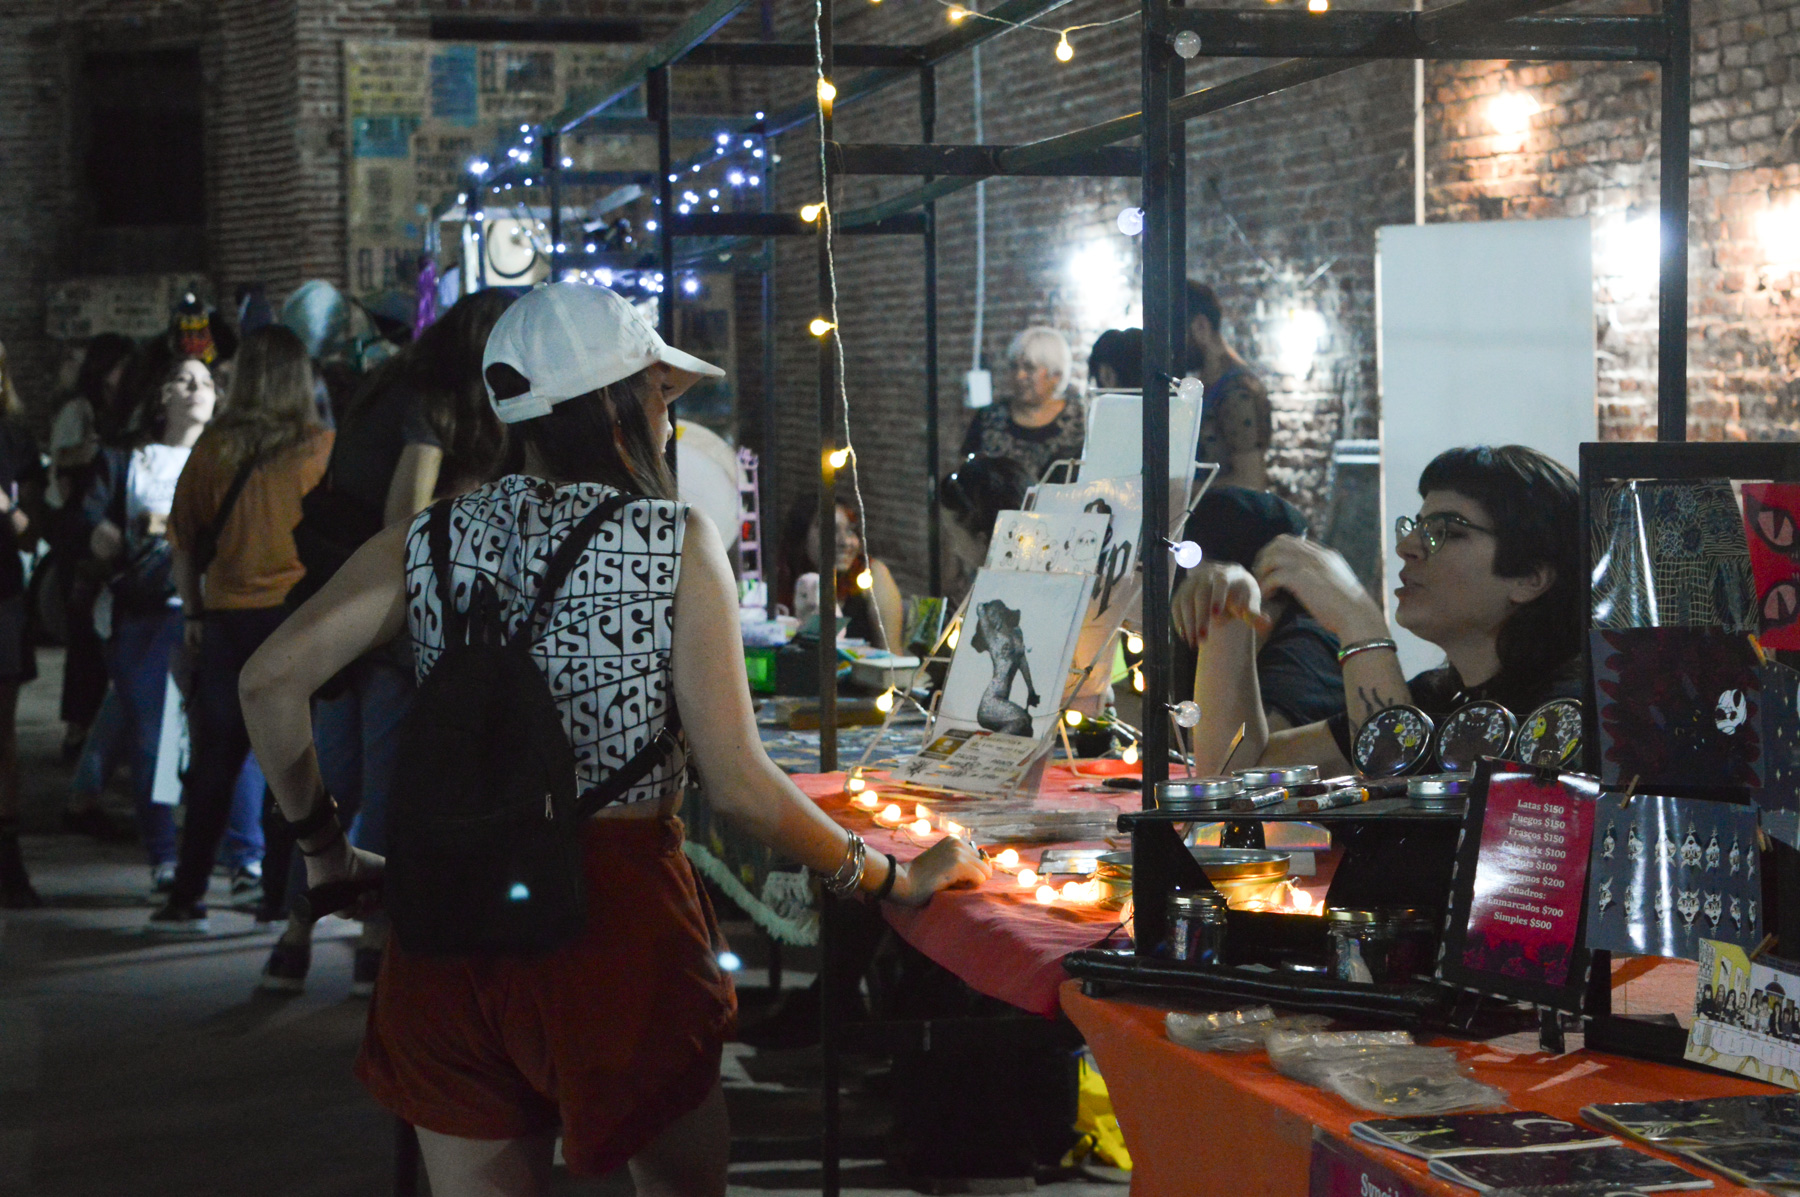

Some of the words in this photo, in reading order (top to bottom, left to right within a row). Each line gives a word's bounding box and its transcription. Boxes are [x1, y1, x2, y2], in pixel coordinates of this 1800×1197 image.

[1517, 799, 1541, 811] Latas
[1543, 803, 1565, 815] $150
[1511, 812, 1543, 826] Fuegos
[1544, 818, 1566, 830] $150
[1508, 826, 1541, 841] Frascos
[1543, 833, 1565, 845] $150
[1502, 840, 1530, 853] Calcos
[1532, 845, 1543, 855] 4x
[1545, 847, 1566, 859] $100
[1536, 860, 1557, 873] $100
[1542, 876, 1565, 889] $200
[1508, 885, 1547, 900] Cuadros:
[1487, 896, 1540, 913] Enmarcados
[1541, 904, 1564, 918] $700
[1494, 911, 1528, 926] Simples
[1530, 918, 1552, 931] $500
